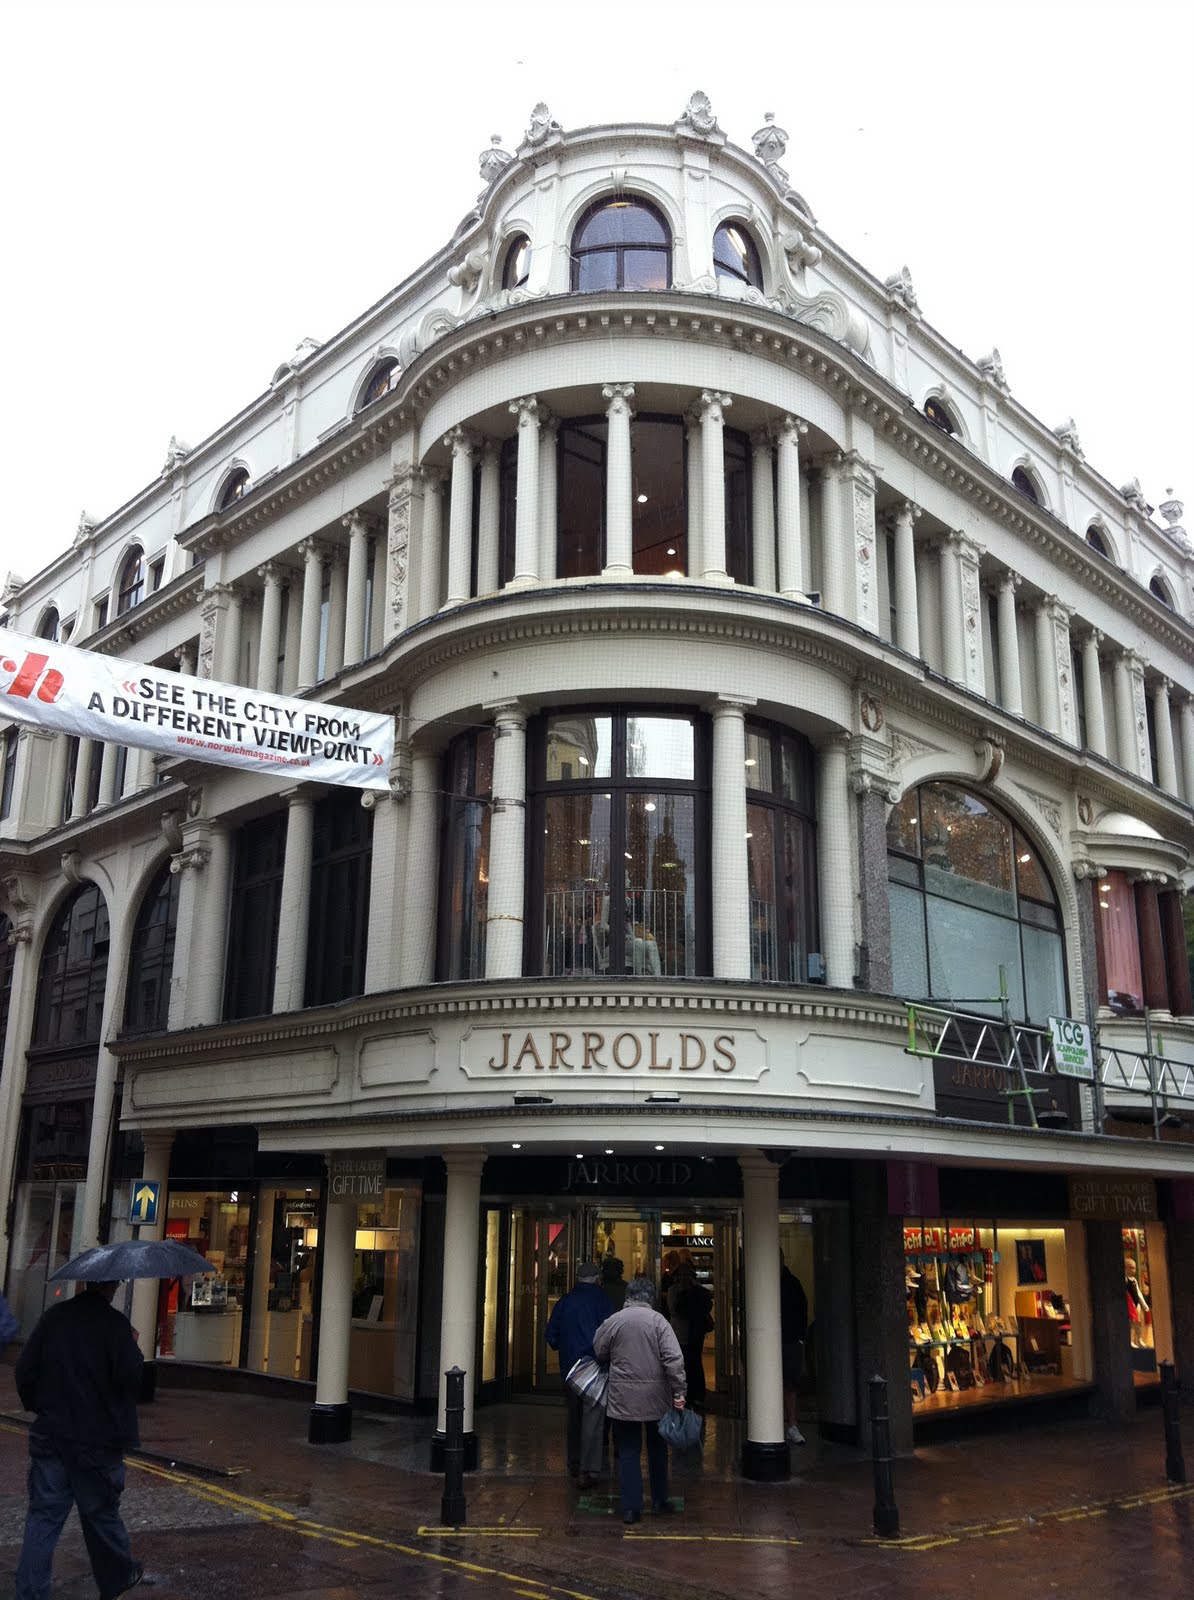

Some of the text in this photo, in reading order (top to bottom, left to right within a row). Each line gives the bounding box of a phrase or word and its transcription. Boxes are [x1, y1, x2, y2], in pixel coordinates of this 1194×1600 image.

[87, 691, 105, 714] A
[112, 696, 247, 742] DIFFERENT
[191, 690, 237, 718] THE
[243, 701, 298, 729] CITY
[304, 714, 361, 741] FROM
[177, 735, 311, 767] www.norwichmagazine.co.uk
[1056, 1019, 1084, 1047] TCG
[488, 1031, 737, 1072] JARROLDS
[332, 1175, 383, 1195] GIFT TIME
[561, 1161, 691, 1191] JARROLD
[169, 1199, 198, 1209] RINS
[1074, 1195, 1152, 1214] GIFT TIME
